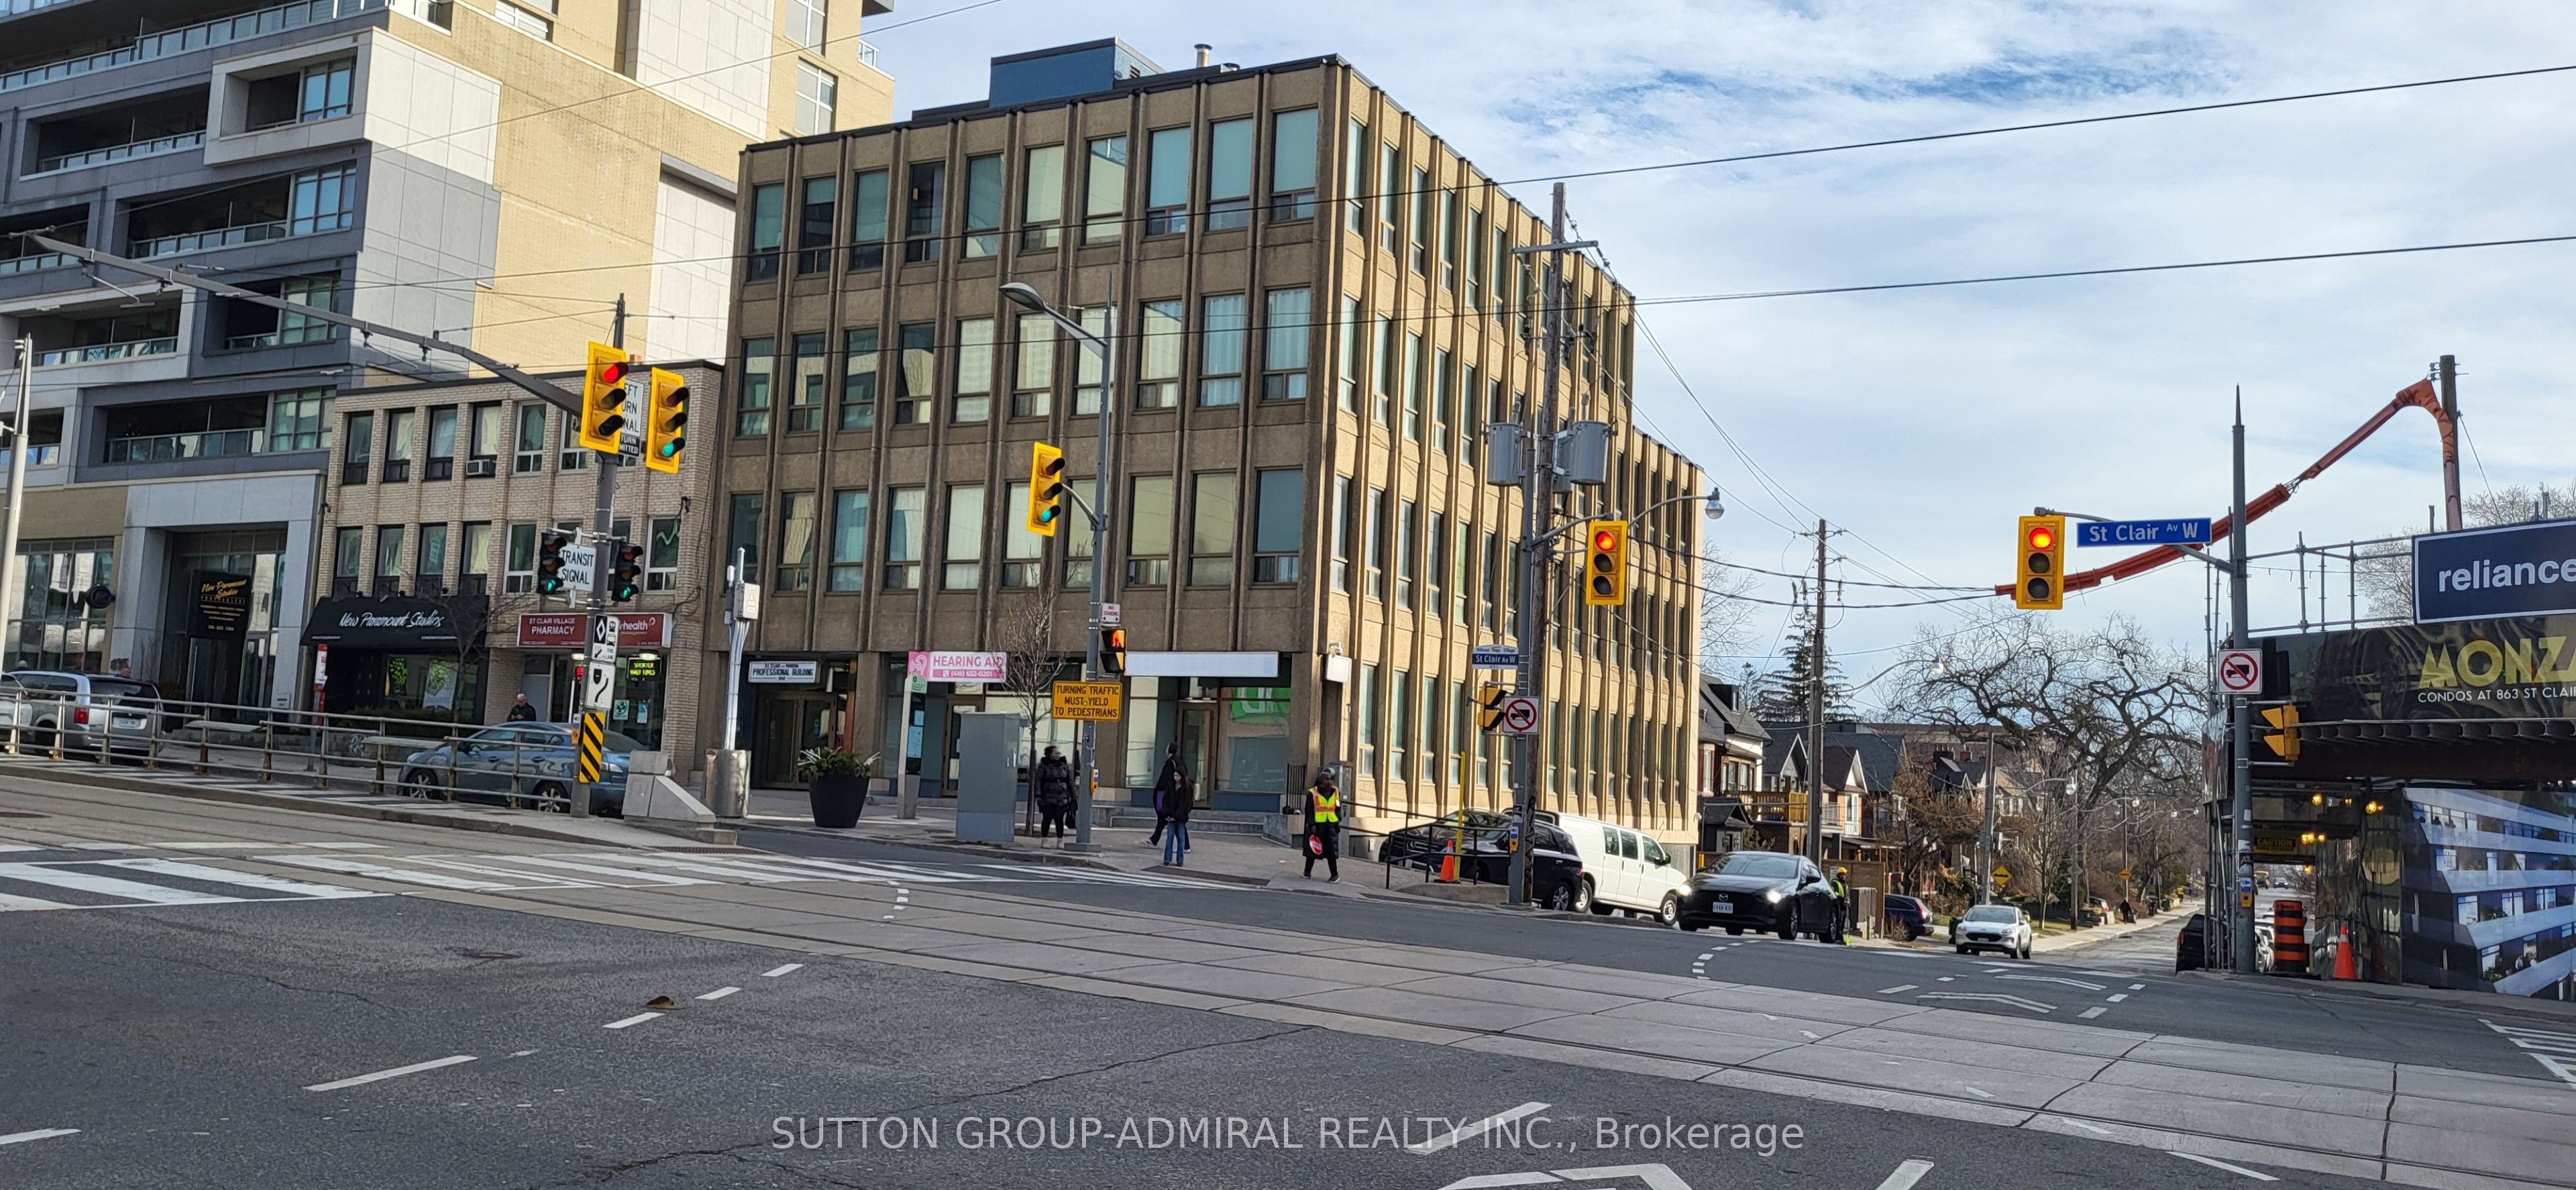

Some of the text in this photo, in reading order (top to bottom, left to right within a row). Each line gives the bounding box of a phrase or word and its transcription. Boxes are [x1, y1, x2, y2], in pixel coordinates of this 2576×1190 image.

[624, 383, 638, 397] EFT
[622, 400, 637, 415] URN
[2090, 522, 2198, 542] St Clair Av W
[561, 549, 594, 567] TRANSIT
[561, 567, 590, 585] SIGNAL
[2438, 558, 2576, 592] reliance
[339, 609, 445, 628] New Paramount Studios
[531, 626, 575, 635] PHARMACY
[933, 655, 1004, 667] HEARING AID
[1476, 655, 1483, 663] St
[1484, 655, 1501, 663] Clair
[1509, 655, 1516, 663] W
[2418, 636, 2576, 688] MONZ
[752, 668, 814, 676] PROFESSIONAL BUILDING
[1057, 685, 1119, 696] TURNING TRAFFIC
[2418, 690, 2472, 703] CONDOS
[2477, 690, 2491, 701] AT
[2496, 688, 2519, 700] 863
[2524, 688, 2537, 699] ST
[1064, 696, 1109, 706] MUST YIELD
[1055, 706, 1118, 718] TO PEDESTRIANS
[2257, 837, 2293, 847] CAUTION
